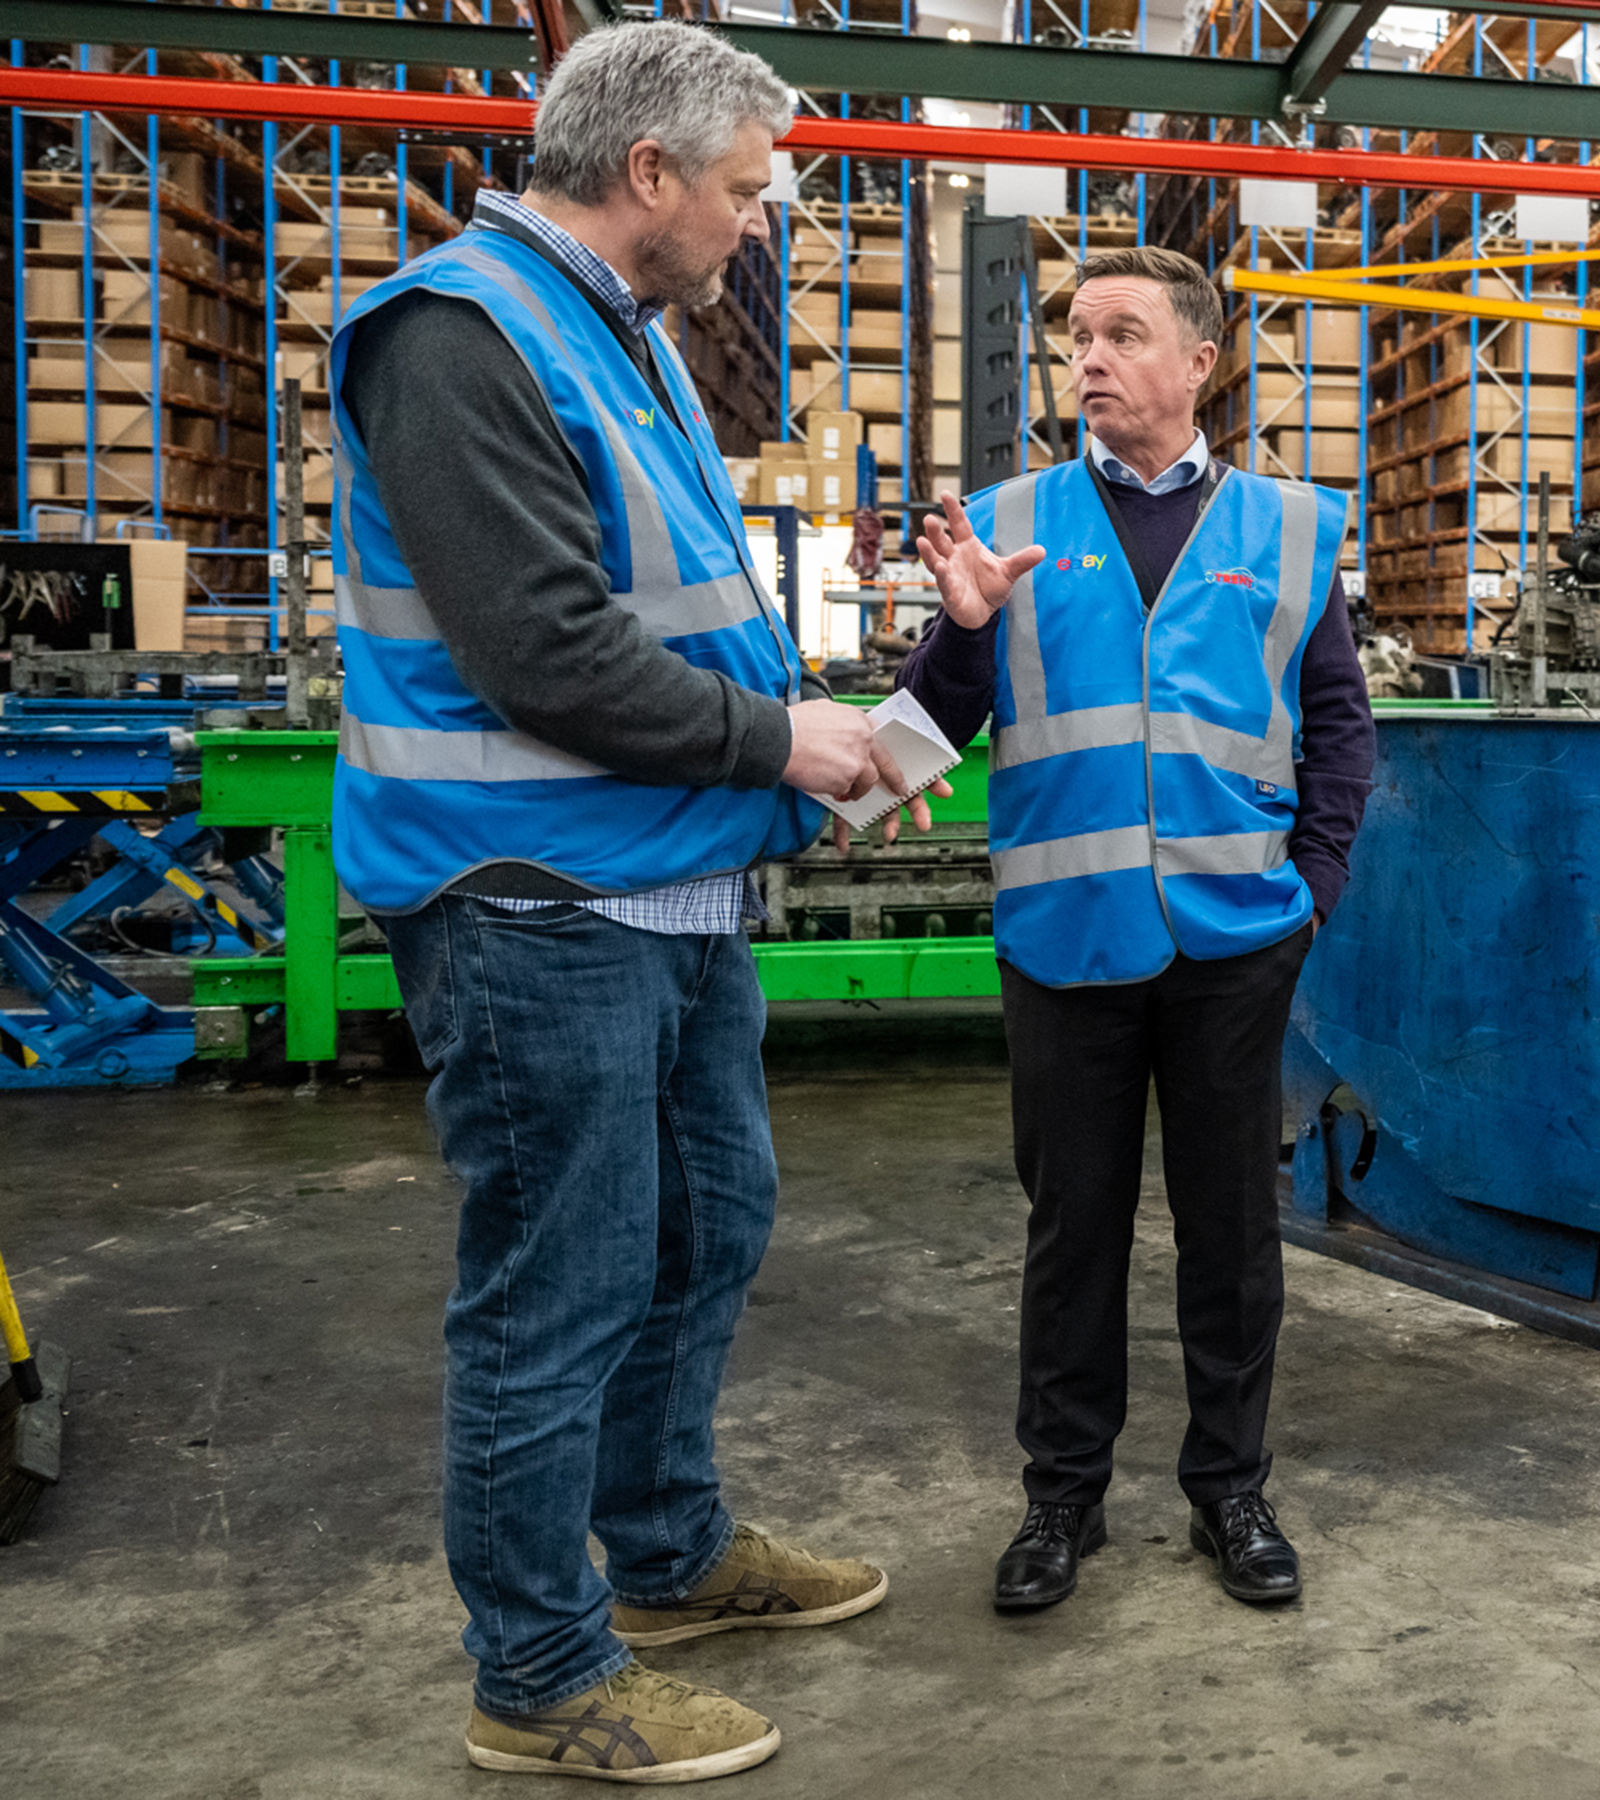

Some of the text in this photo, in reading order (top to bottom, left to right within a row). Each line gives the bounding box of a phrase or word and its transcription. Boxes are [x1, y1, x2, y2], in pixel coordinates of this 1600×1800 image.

[1056, 554, 1107, 571] ebay
[1213, 572, 1253, 589] TRENT
[1471, 581, 1496, 598] CE
